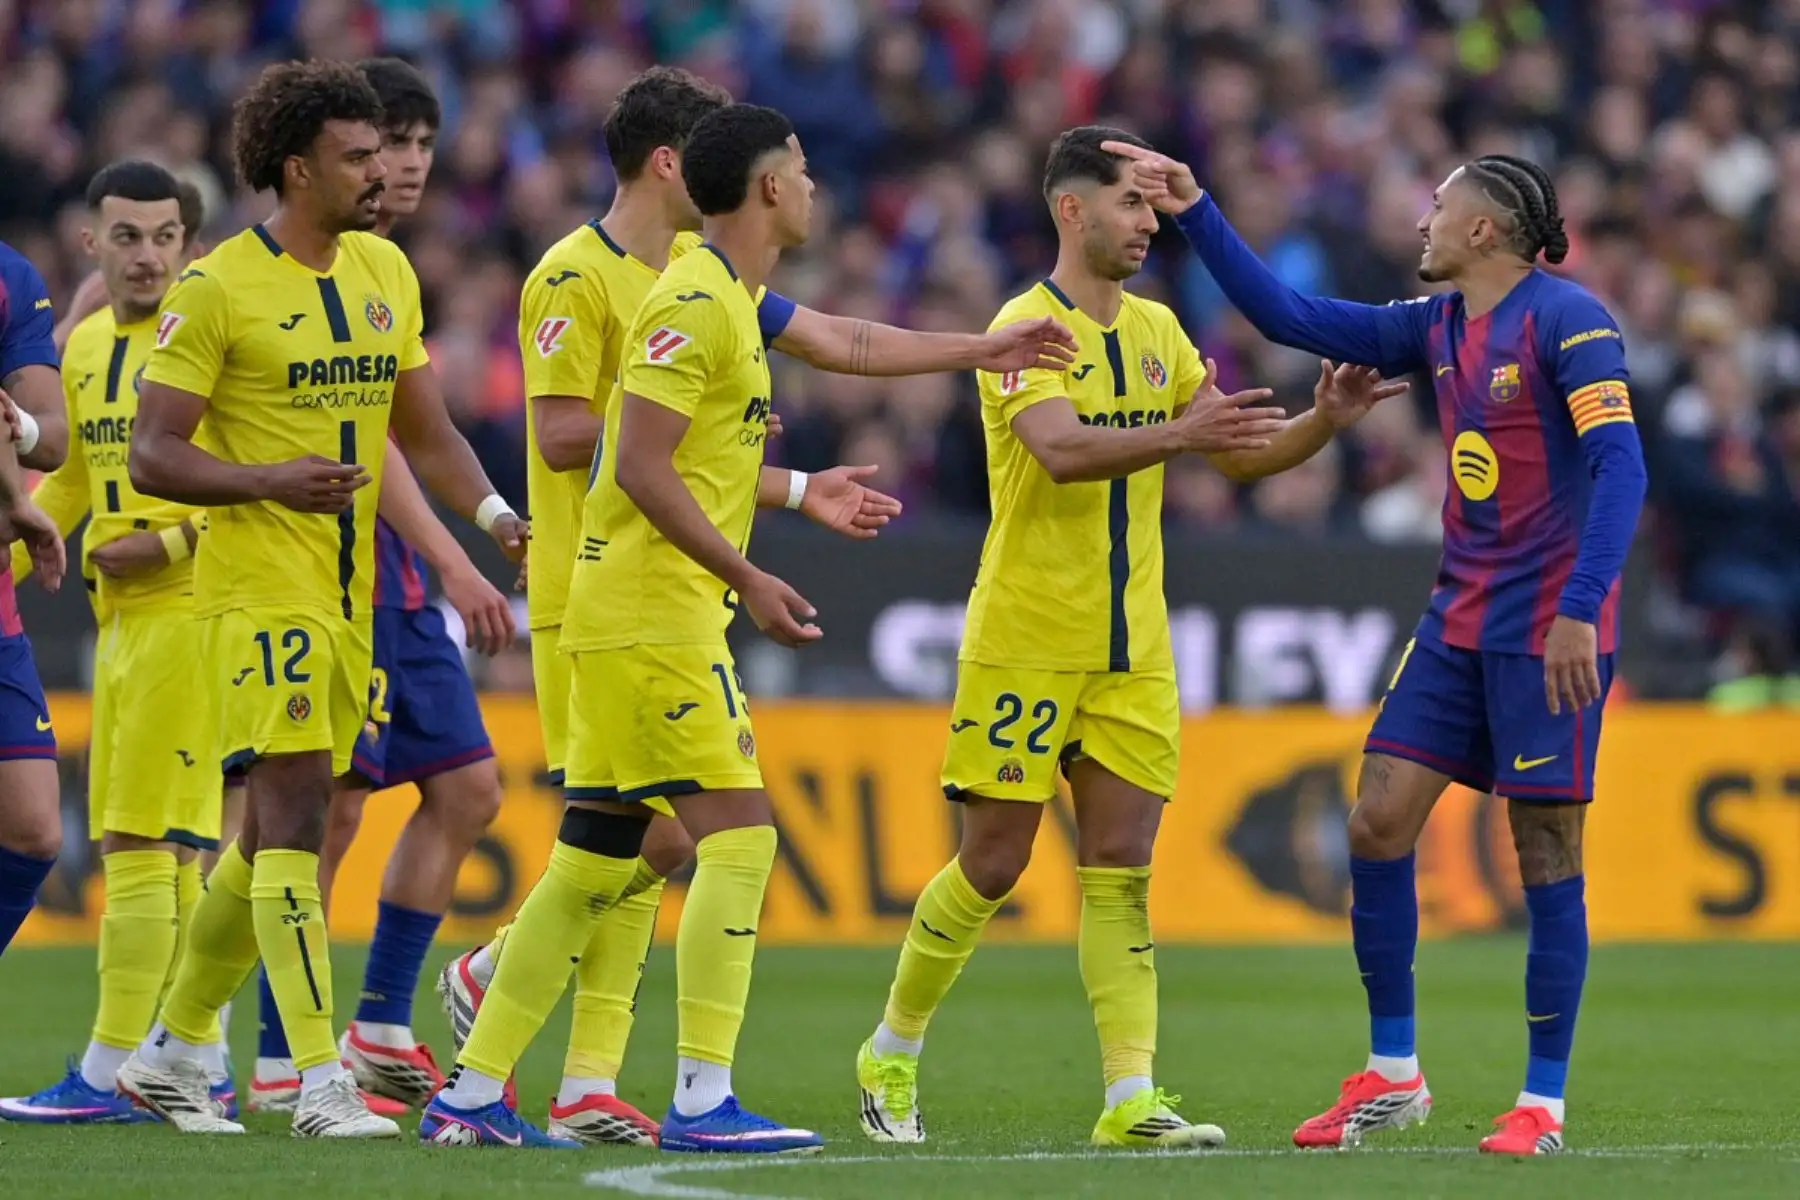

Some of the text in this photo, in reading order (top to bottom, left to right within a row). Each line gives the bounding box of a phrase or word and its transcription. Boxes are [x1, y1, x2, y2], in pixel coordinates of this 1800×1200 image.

[288, 354, 397, 388] PAMESA
[254, 628, 312, 687] 12
[988, 692, 1058, 754] 22
